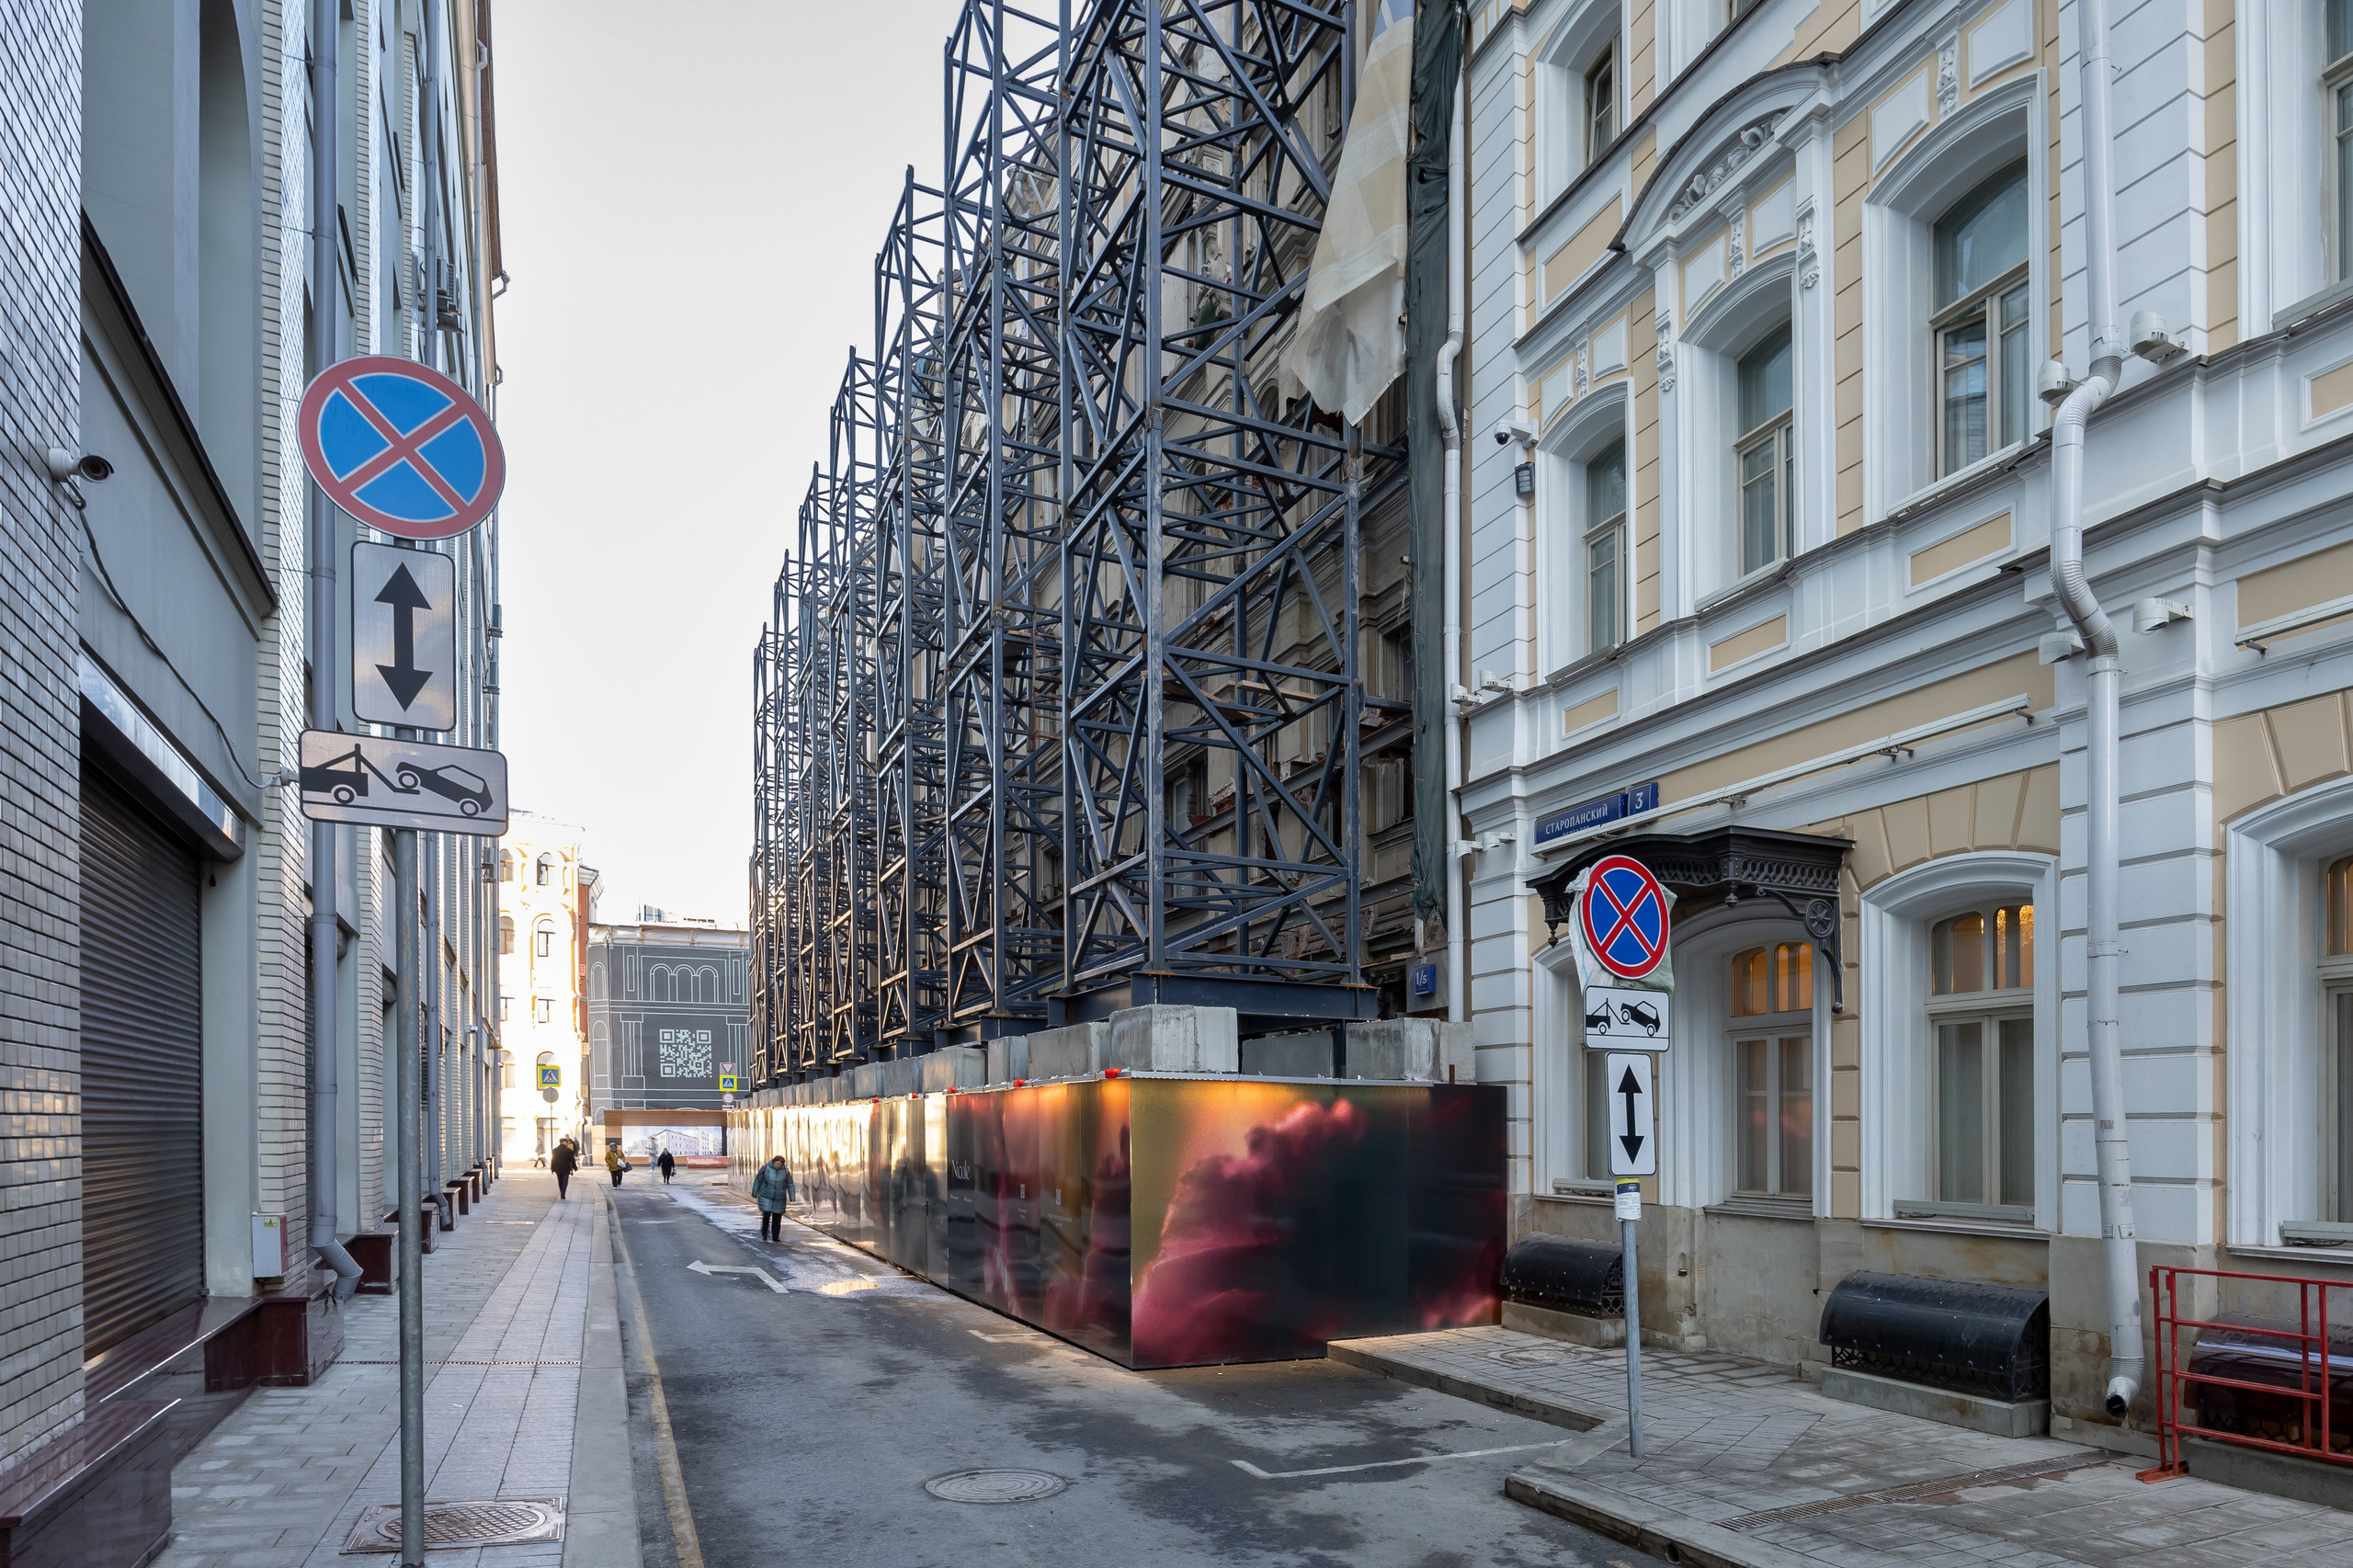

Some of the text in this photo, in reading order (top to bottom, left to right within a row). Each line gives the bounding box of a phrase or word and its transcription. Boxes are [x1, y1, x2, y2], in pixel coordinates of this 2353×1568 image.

[1635, 791, 1643, 809] 3
[1545, 803, 1608, 835] СТАРОПАНСКИЙ
[1415, 970, 1427, 986] 1/5
